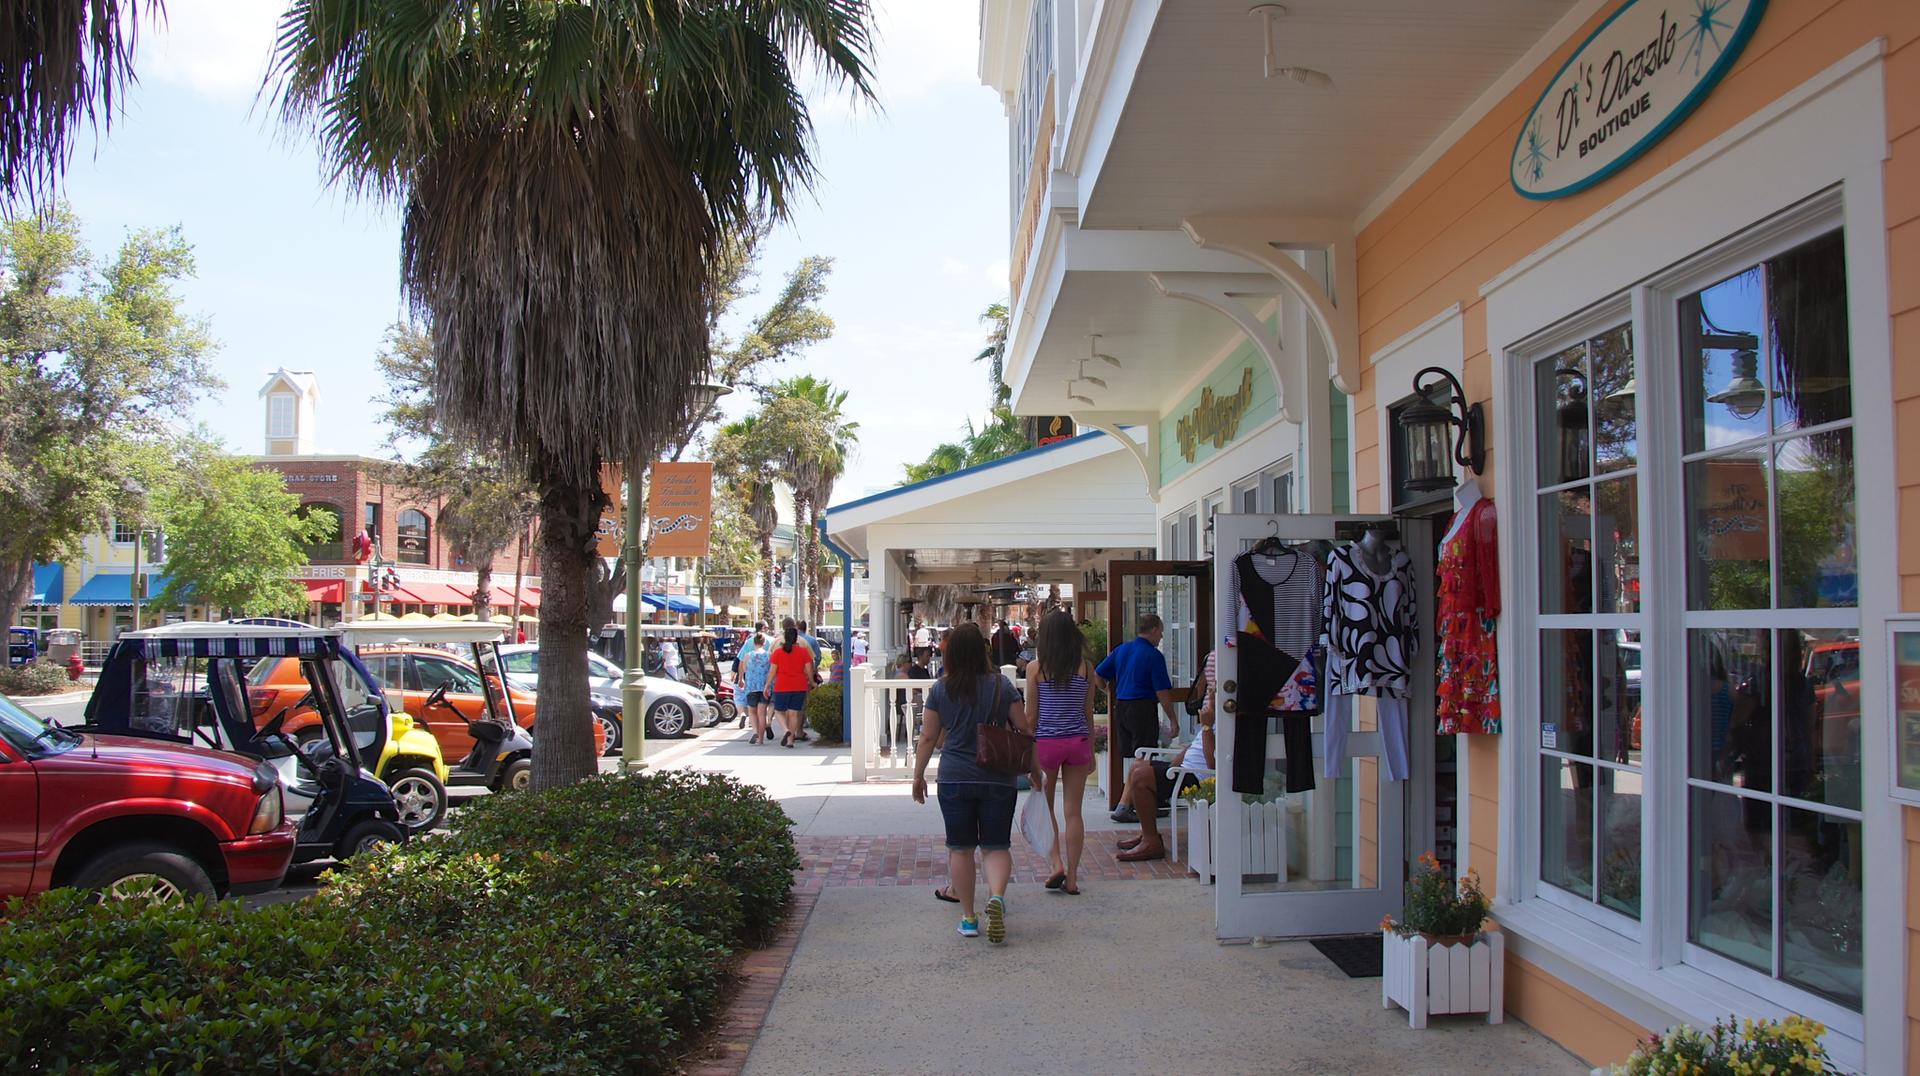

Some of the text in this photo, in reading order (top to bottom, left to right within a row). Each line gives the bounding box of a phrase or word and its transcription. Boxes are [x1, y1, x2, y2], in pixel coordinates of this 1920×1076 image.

[1555, 9, 1680, 159] Di's Dazzle
[1579, 92, 1652, 159] BOUTIQUE
[309, 474, 338, 482] STORE
[312, 567, 346, 578] FRIES
